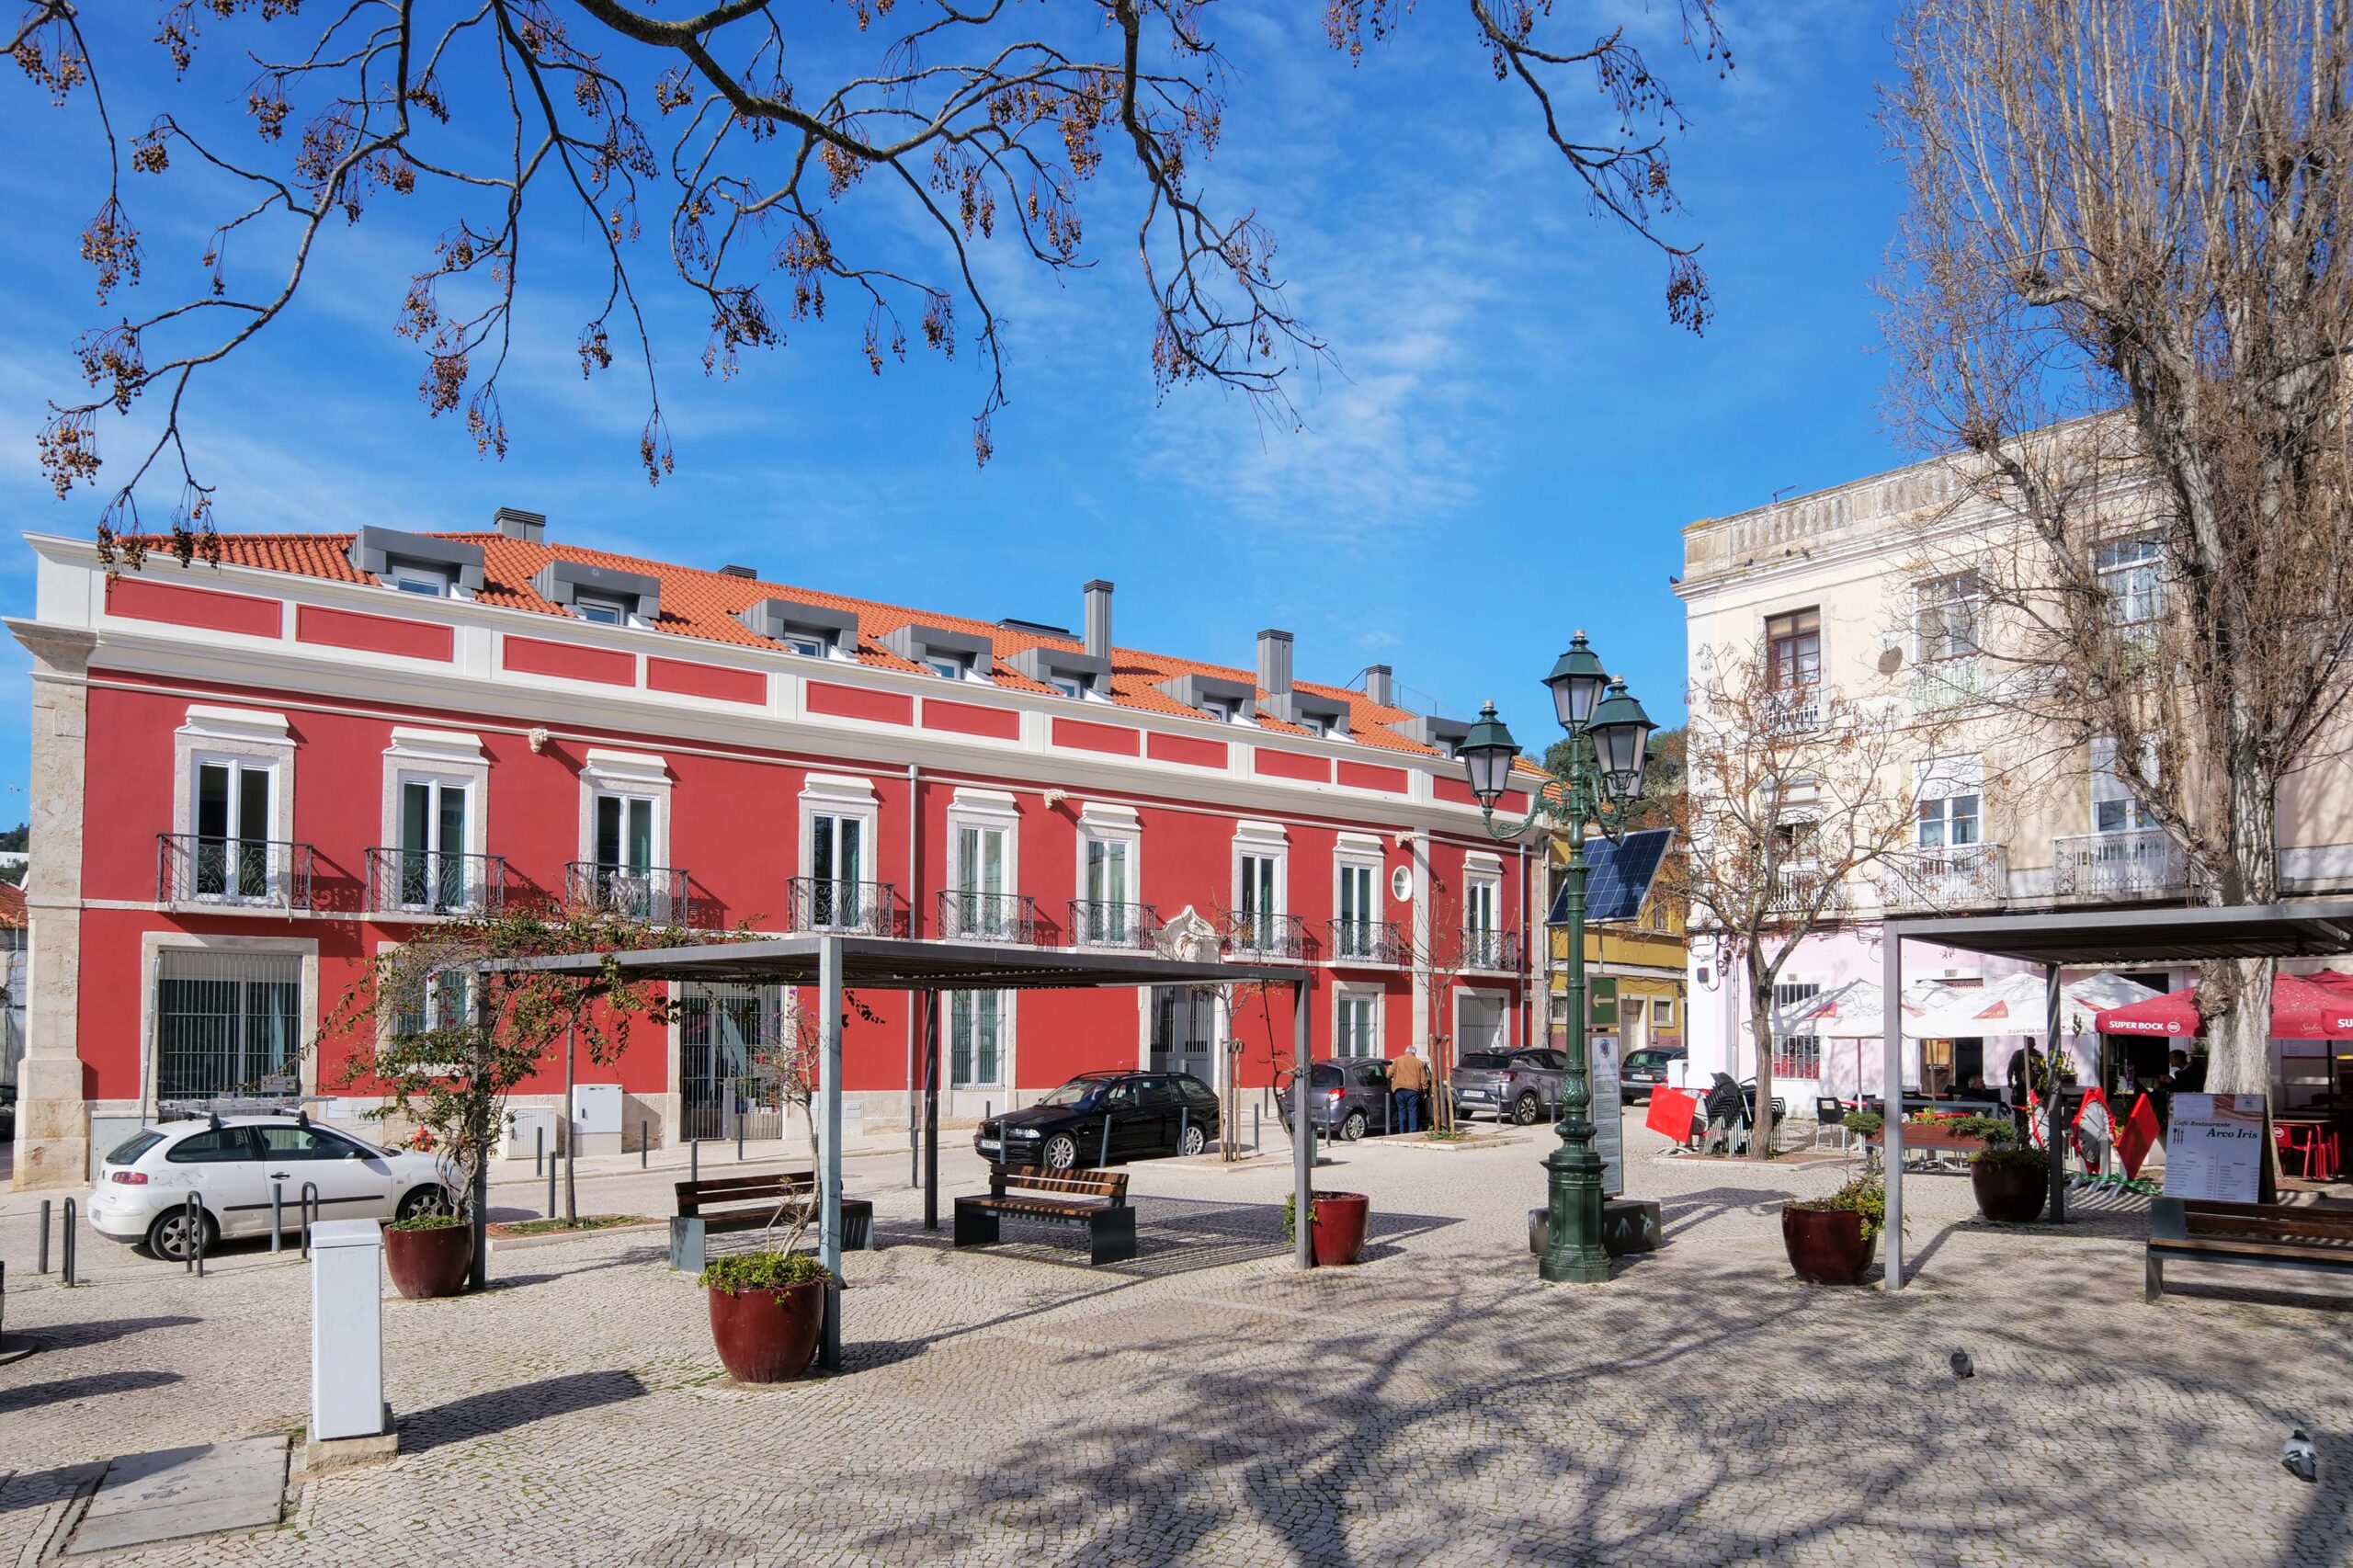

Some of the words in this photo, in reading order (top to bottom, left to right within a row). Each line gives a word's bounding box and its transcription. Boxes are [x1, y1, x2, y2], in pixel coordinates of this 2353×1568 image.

[2109, 1020, 2137, 1029] SUPER
[2138, 1022, 2164, 1030] BOCK
[2206, 1128, 2234, 1138] Arco
[2236, 1129, 2258, 1139] Iris
